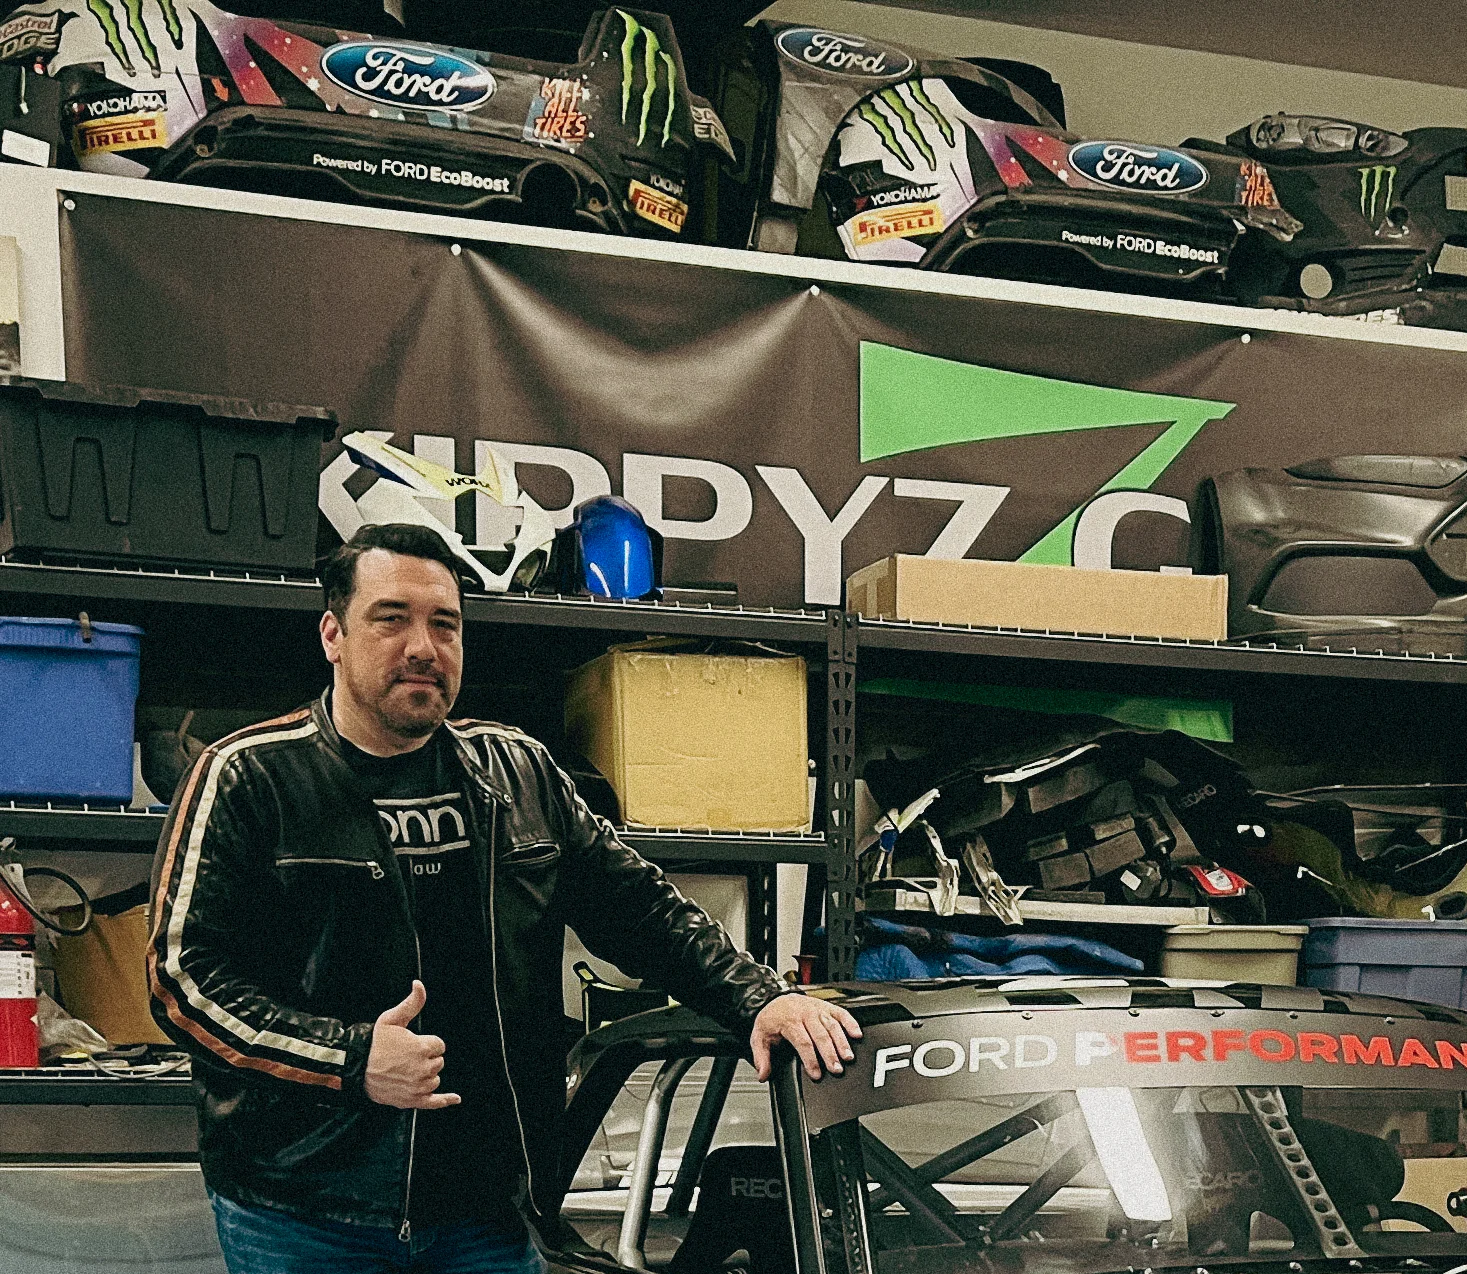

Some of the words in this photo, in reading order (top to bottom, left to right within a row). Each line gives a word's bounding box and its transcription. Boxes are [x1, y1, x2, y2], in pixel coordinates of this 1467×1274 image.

[0, 34, 59, 61] DGE
[804, 33, 889, 75] Ford
[354, 45, 461, 102] Ford
[544, 98, 583, 118] ALL
[79, 119, 157, 150] PIRELLI
[534, 114, 587, 140] TIRES
[313, 153, 359, 172] Powered
[361, 160, 377, 177] by
[382, 158, 427, 180] FORD
[430, 166, 510, 193] EcoBoost
[1095, 144, 1181, 189] Ford
[858, 208, 935, 241] PIRELLI
[1062, 230, 1101, 247] Powered
[1102, 235, 1115, 249] by
[1116, 234, 1154, 253] FORD
[1155, 240, 1219, 264] EcoBoost
[873, 1035, 1055, 1088] FORD
[730, 1177, 783, 1199] REC
